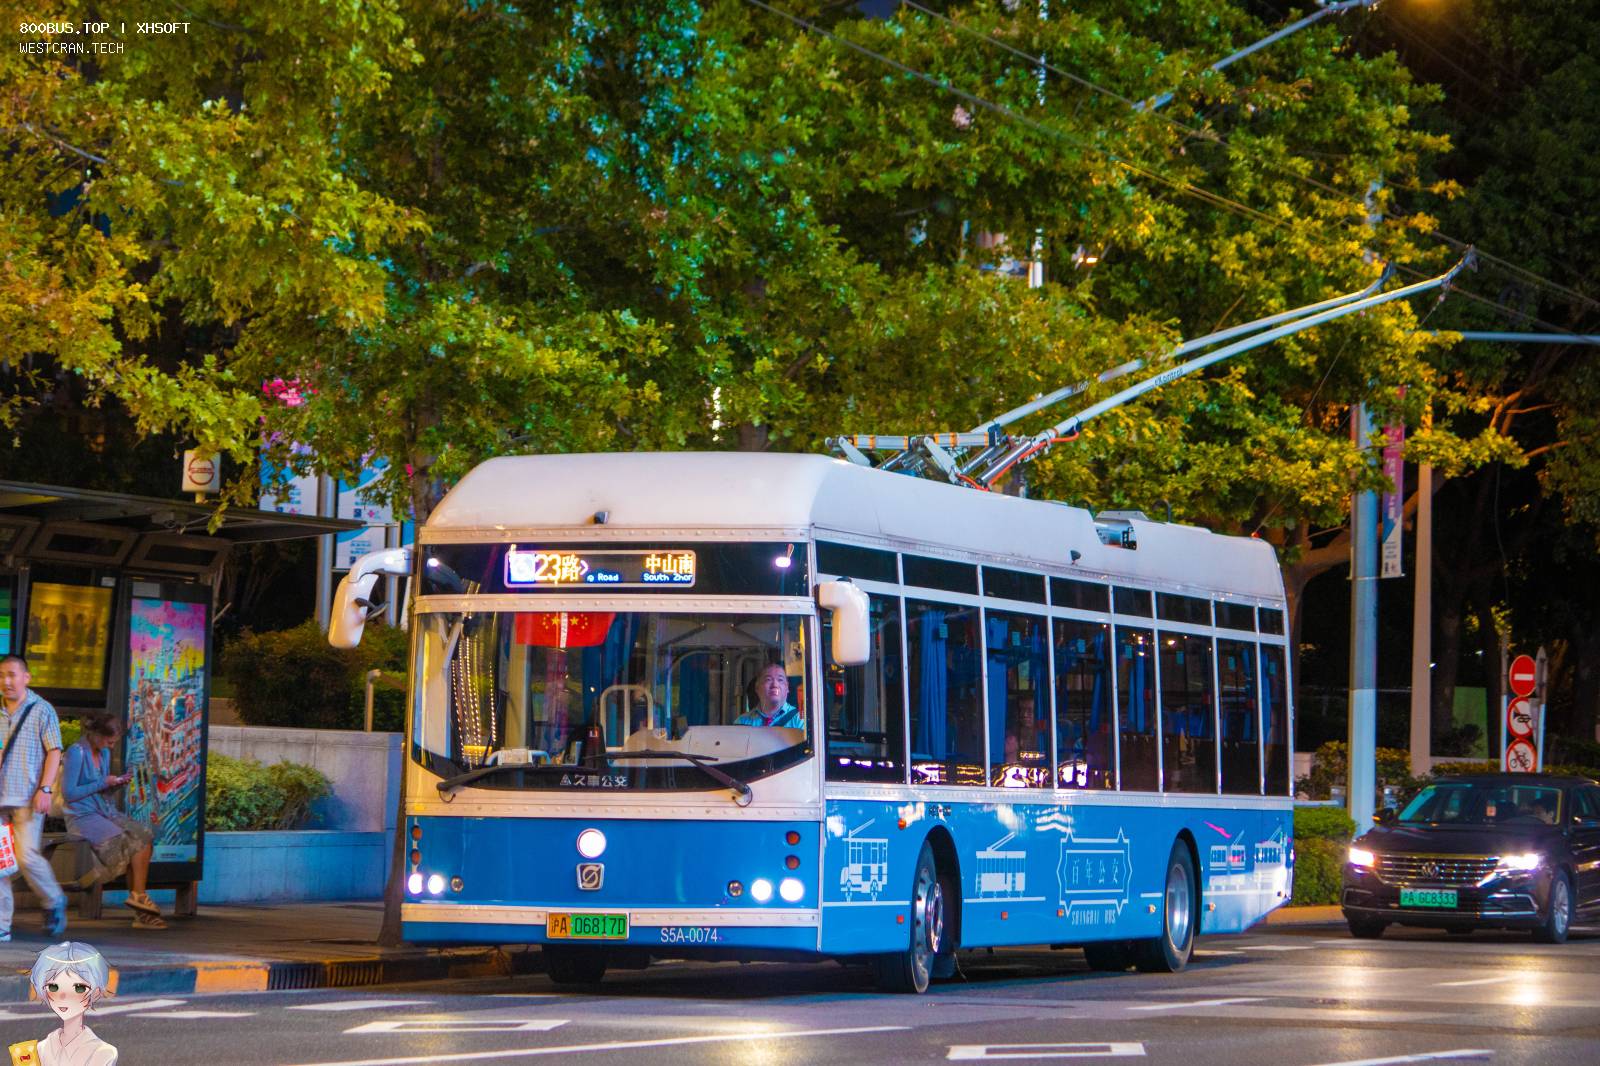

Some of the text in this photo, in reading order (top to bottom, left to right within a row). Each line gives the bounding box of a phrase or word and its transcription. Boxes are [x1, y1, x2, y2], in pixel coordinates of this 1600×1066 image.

[535, 554, 579, 582] 23路
[645, 553, 694, 574] 中山南
[598, 573, 619, 582] Road
[643, 573, 670, 582] South
[660, 927, 718, 943] S5A-0074
